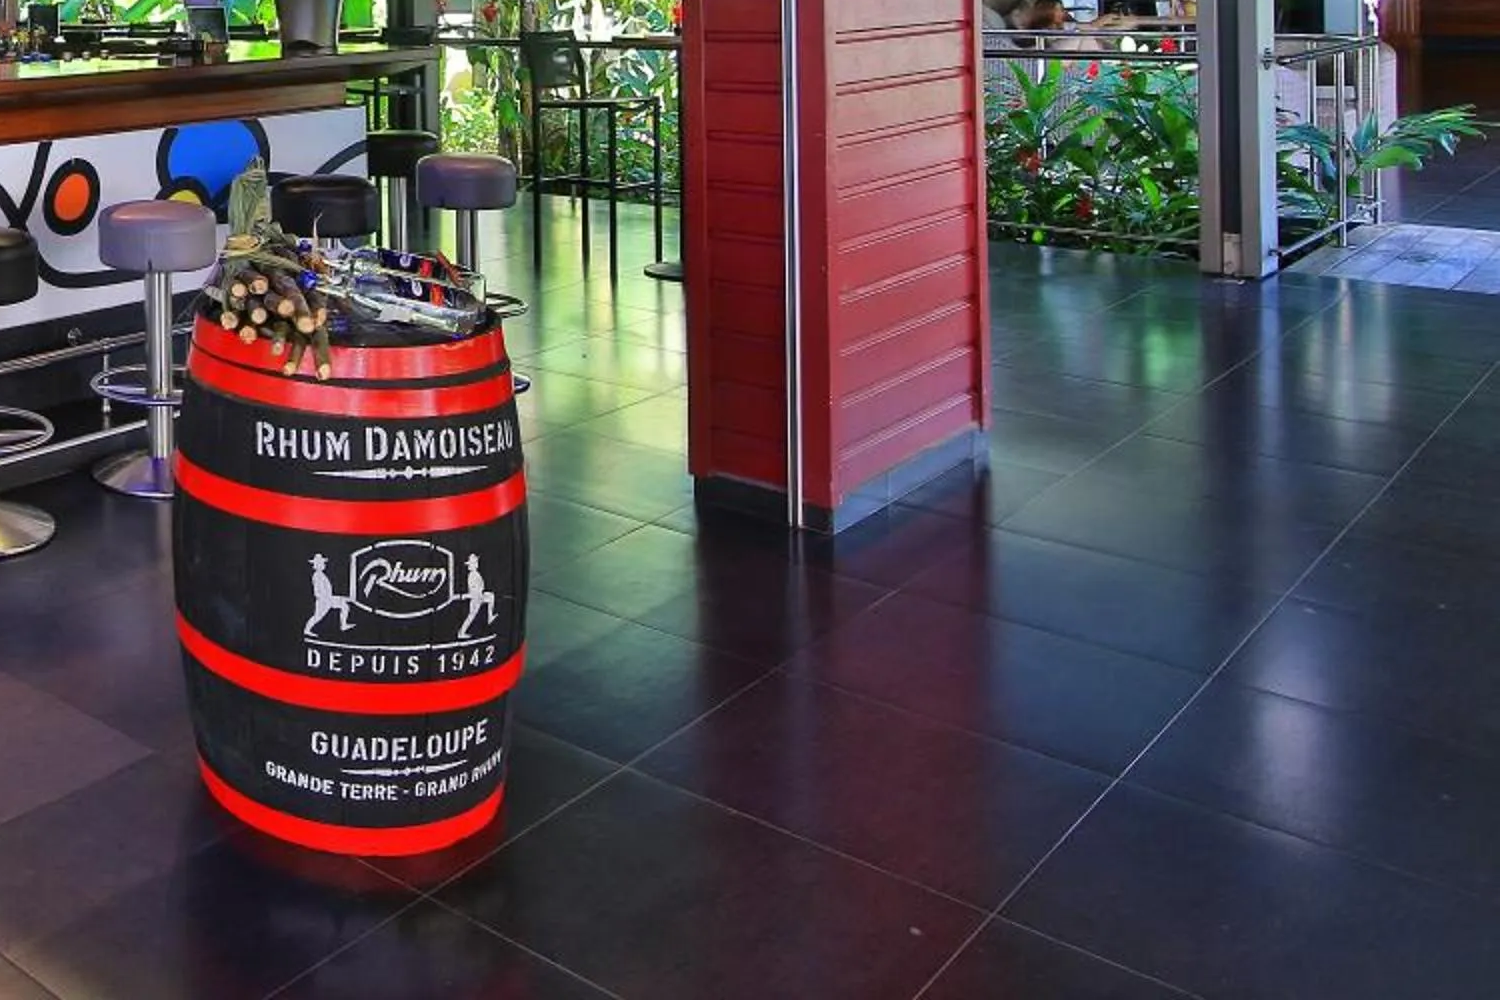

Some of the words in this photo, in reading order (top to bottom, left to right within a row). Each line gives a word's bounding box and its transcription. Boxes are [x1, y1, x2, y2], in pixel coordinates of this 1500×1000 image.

[255, 420, 350, 462] RHUM
[365, 418, 514, 462] DAMOISEAU
[358, 557, 446, 599] Rhum
[307, 648, 420, 675] DEPUIS
[437, 645, 496, 673] 1942
[311, 718, 489, 762] GUADELOUPE
[265, 760, 335, 796] GRANDE
[340, 781, 399, 801] TERRE
[415, 772, 469, 797] GRAND
